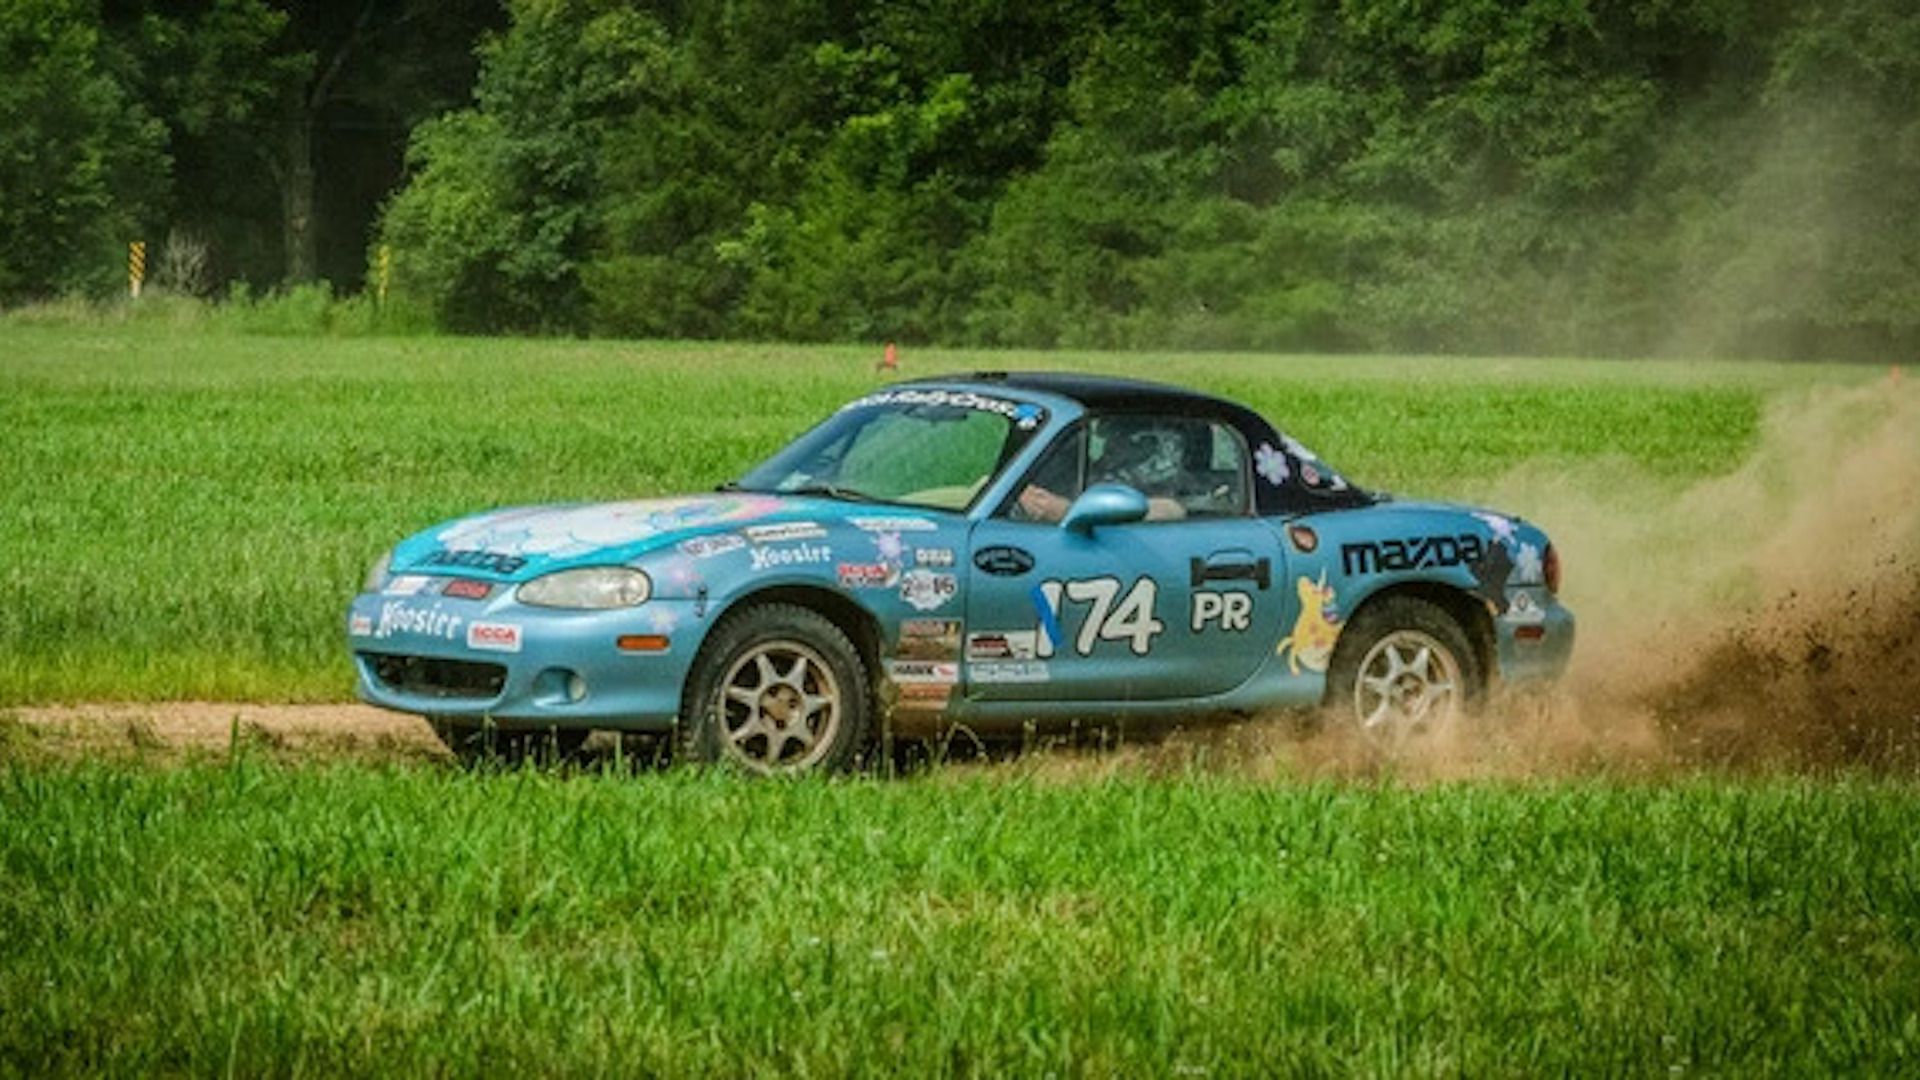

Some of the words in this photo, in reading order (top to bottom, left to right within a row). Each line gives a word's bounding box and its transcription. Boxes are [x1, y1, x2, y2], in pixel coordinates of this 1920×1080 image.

[750, 541, 832, 570] Hoosier
[1341, 533, 1480, 577] mazda
[376, 601, 461, 640] Hoosier
[1036, 575, 1166, 658] 174
[1190, 589, 1252, 632] PR
